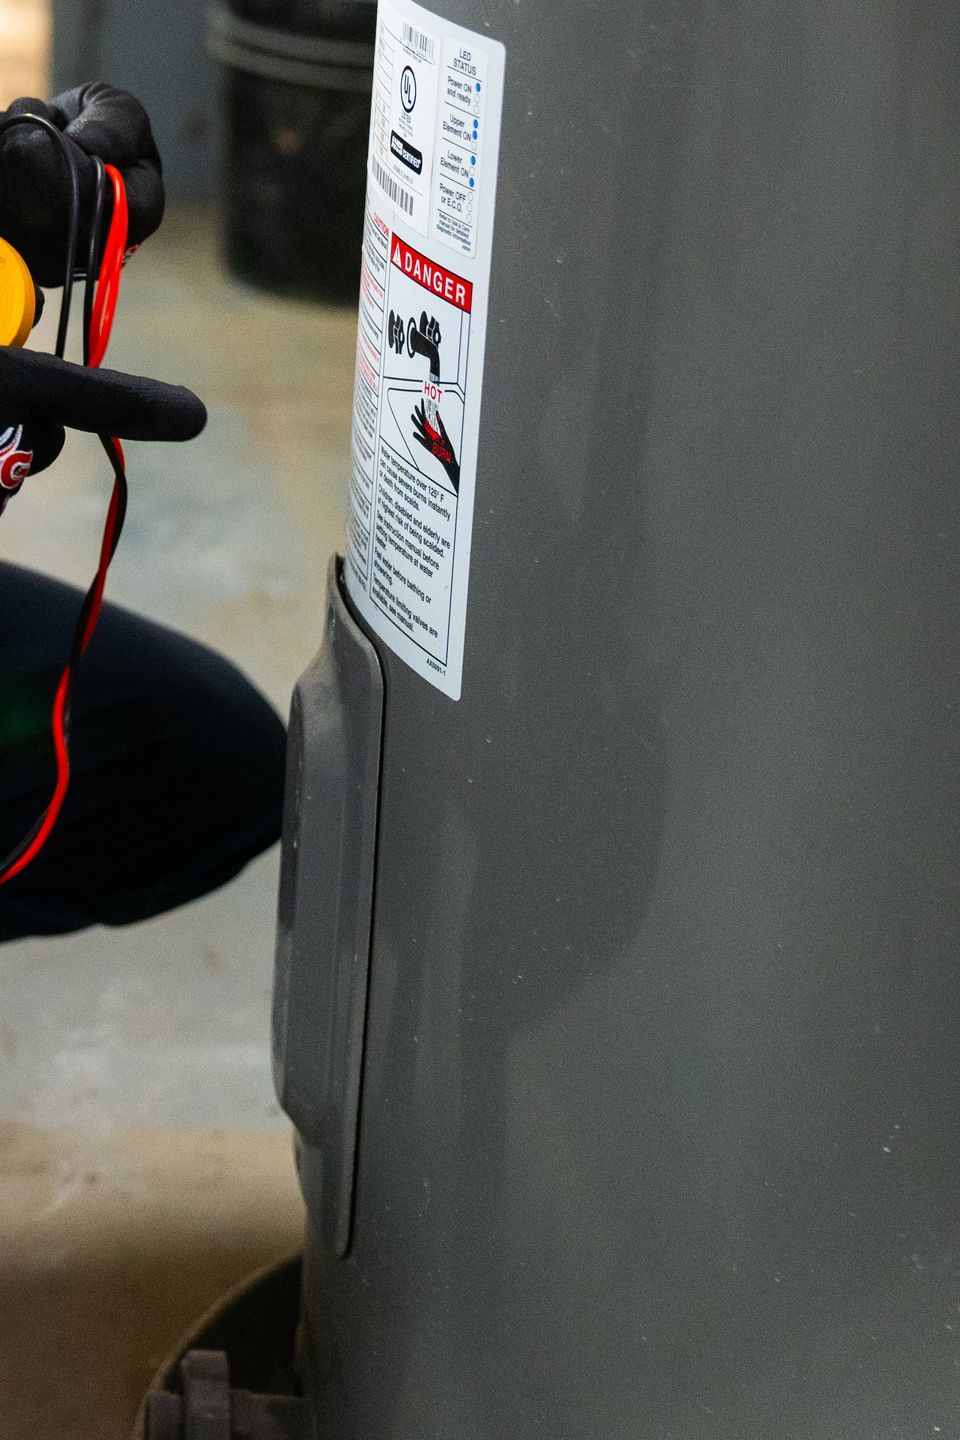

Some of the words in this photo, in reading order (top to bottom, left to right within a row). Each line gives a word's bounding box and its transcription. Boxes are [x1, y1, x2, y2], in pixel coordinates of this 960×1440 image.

[459, 48, 472, 62] LED
[453, 57, 478, 77] STATUS
[448, 75, 463, 90] Power
[464, 83, 472, 95] ON
[447, 87, 456, 98] and
[457, 92, 471, 107] ready
[443, 120, 462, 138] Element
[463, 130, 472, 142] ON
[450, 113, 465, 128] Upper
[440, 156, 460, 175] Element
[460, 166, 469, 178] ON
[447, 149, 463, 165] Lower
[439, 182, 454, 197] Power
[455, 190, 467, 203] OFF
[404, 251, 467, 306] DANGER
[424, 381, 443, 403] HOT
[391, 456, 415, 484] temperature
[416, 478, 427, 491] over
[384, 473, 393, 489] death
[394, 482, 403, 498] from
[387, 465, 398, 481] cause
[398, 476, 413, 494] severe
[413, 486, 427, 504] burns
[428, 497, 451, 521] instantly
[382, 500, 395, 520] highest
[395, 514, 403, 527] risk
[409, 526, 423, 545] being
[394, 502, 412, 522] disabled
[413, 517, 422, 530] and
[423, 524, 440, 544] elderly
[441, 538, 450, 550] are
[383, 517, 404, 543] instruction
[405, 538, 421, 558] manual
[422, 550, 439, 570] before
[388, 534, 413, 563] temperature
[420, 562, 433, 578] water
[382, 556, 392, 571] water
[393, 566, 406, 584] before
[407, 578, 424, 601] bathing
[395, 597, 412, 620] limiting
[412, 613, 428, 631] valves
[429, 627, 438, 638] are
